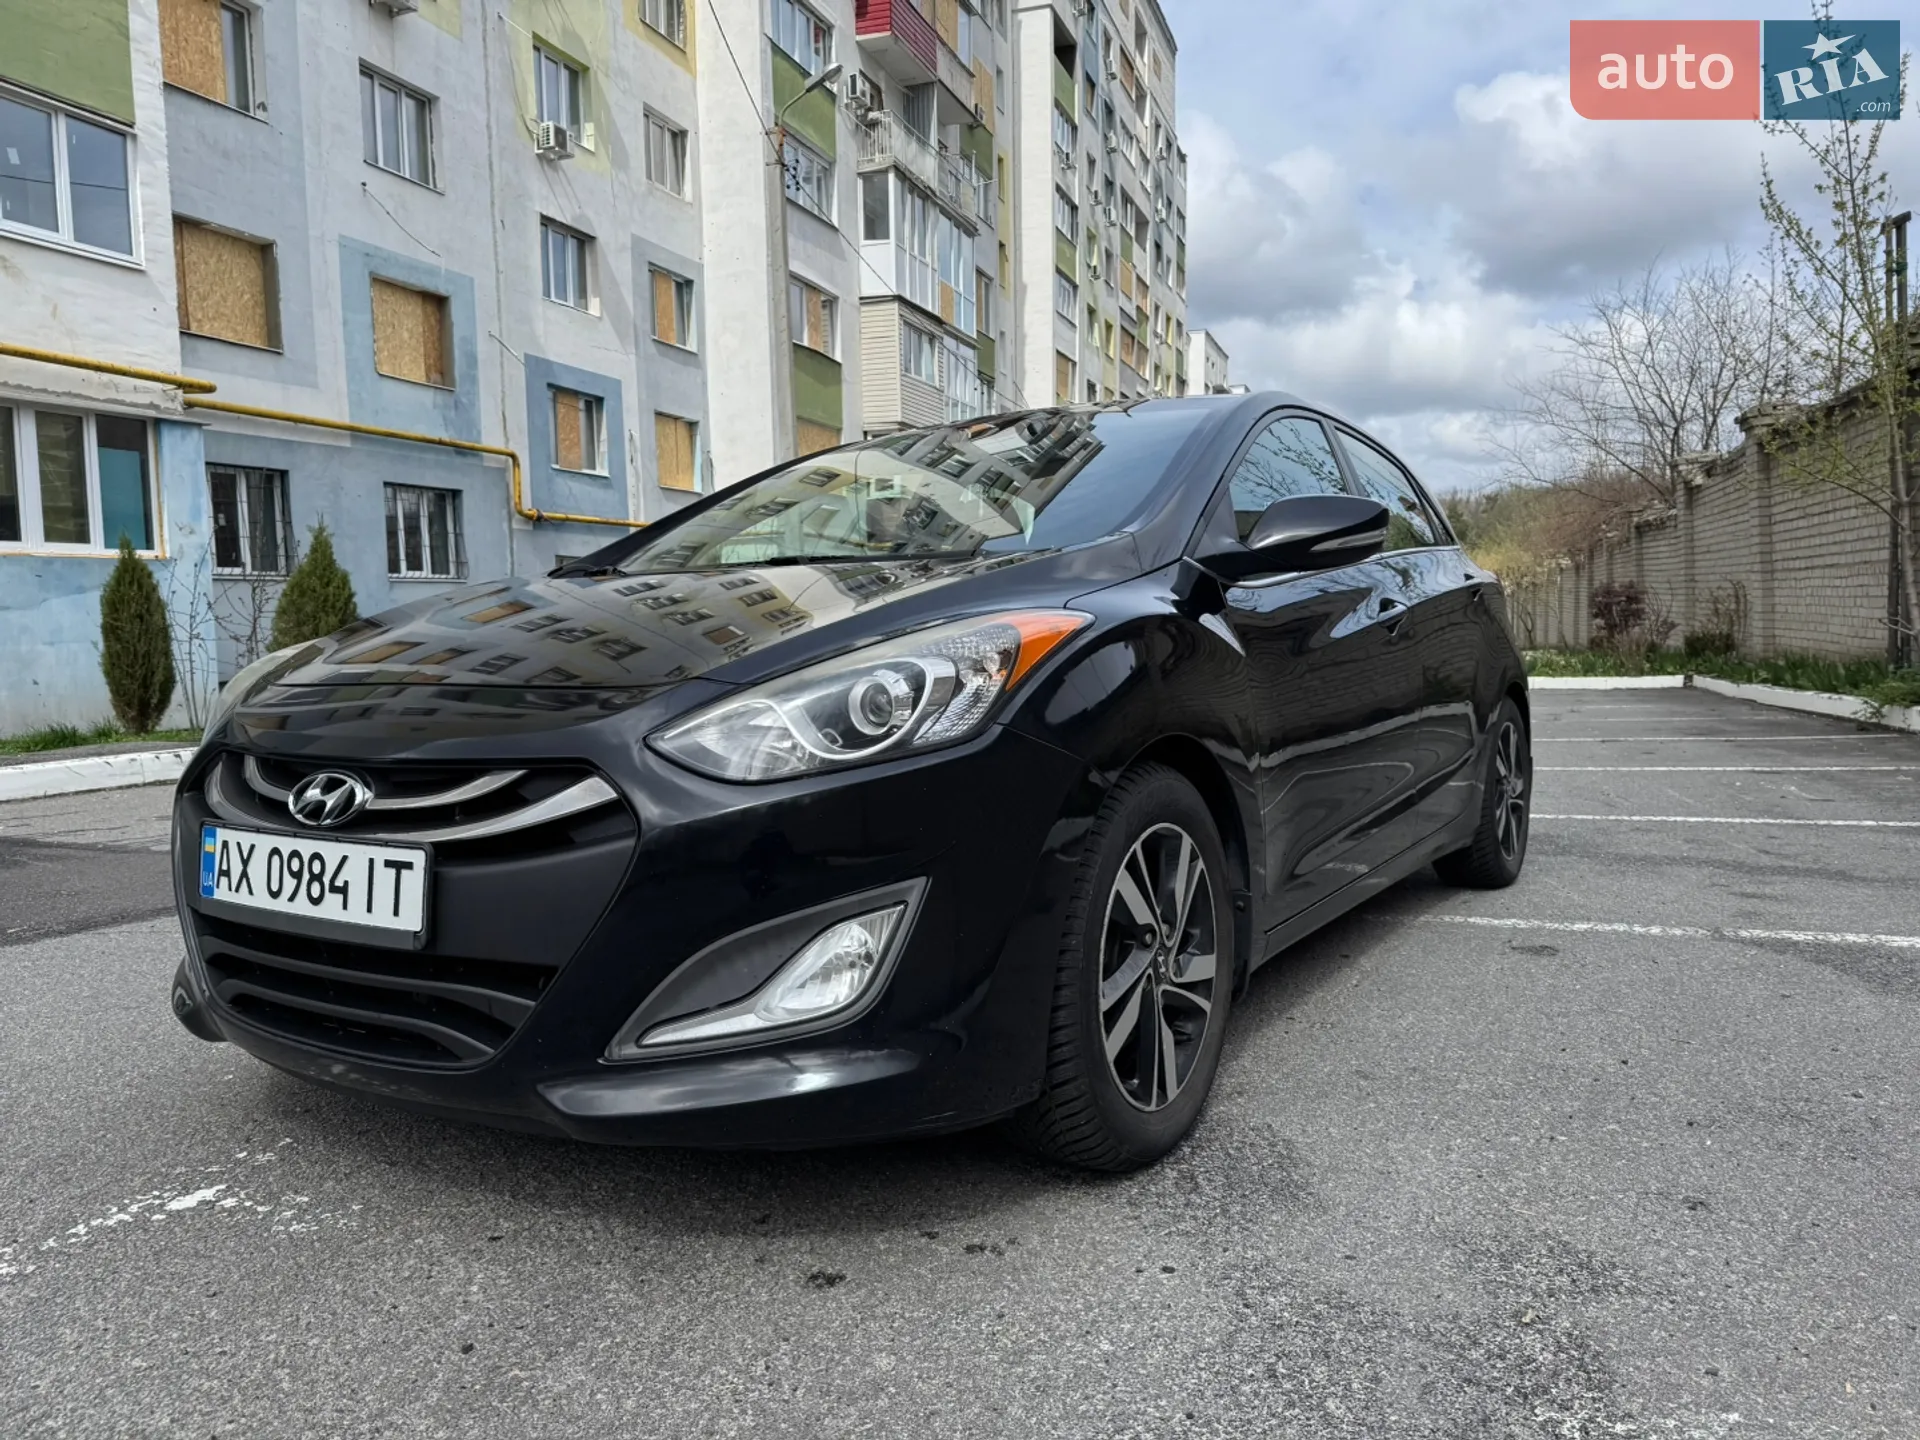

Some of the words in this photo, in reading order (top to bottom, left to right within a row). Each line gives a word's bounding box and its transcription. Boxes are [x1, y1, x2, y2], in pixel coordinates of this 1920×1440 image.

[202, 871, 214, 887] UA
[216, 840, 256, 896] AX
[266, 847, 349, 910] 0984
[366, 857, 414, 917] IT
